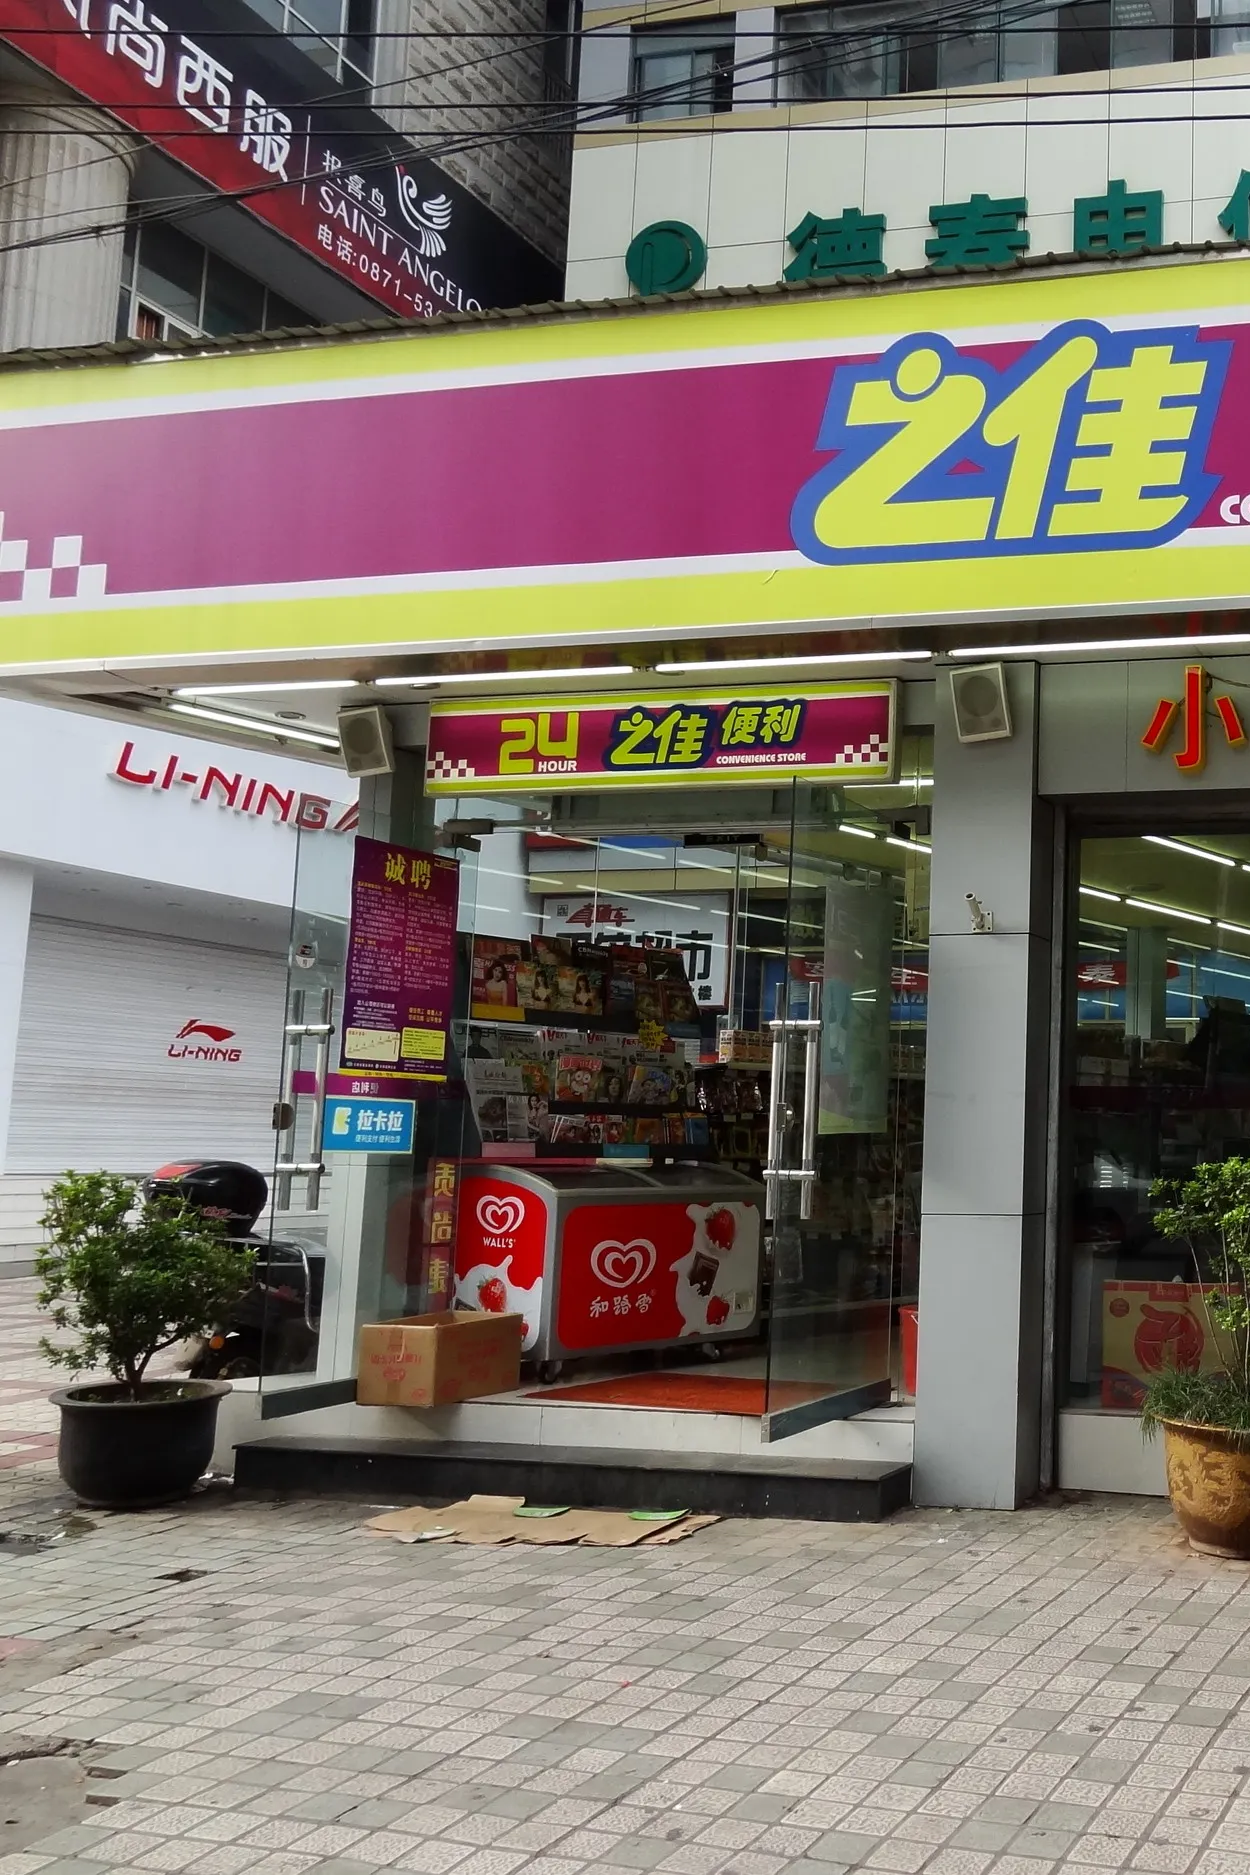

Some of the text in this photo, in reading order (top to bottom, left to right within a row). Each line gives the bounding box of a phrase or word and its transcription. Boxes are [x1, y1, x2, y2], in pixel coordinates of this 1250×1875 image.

[63, 0, 291, 182] 尚西服
[318, 185, 482, 313] SAINT ANGELO
[317, 223, 443, 319] 电话:0871-53
[499, 712, 579, 775] 24
[715, 752, 806, 765] CONVENIENCE STORE
[537, 760, 578, 773] HOUR
[115, 741, 332, 830] LI-NING
[384, 852, 432, 890] 诚聘
[168, 1044, 242, 1062] LI-NING
[357, 1109, 404, 1132] 拉卡拉
[482, 1236, 514, 1249] WALL'S
[589, 1292, 653, 1319] 和路雪
